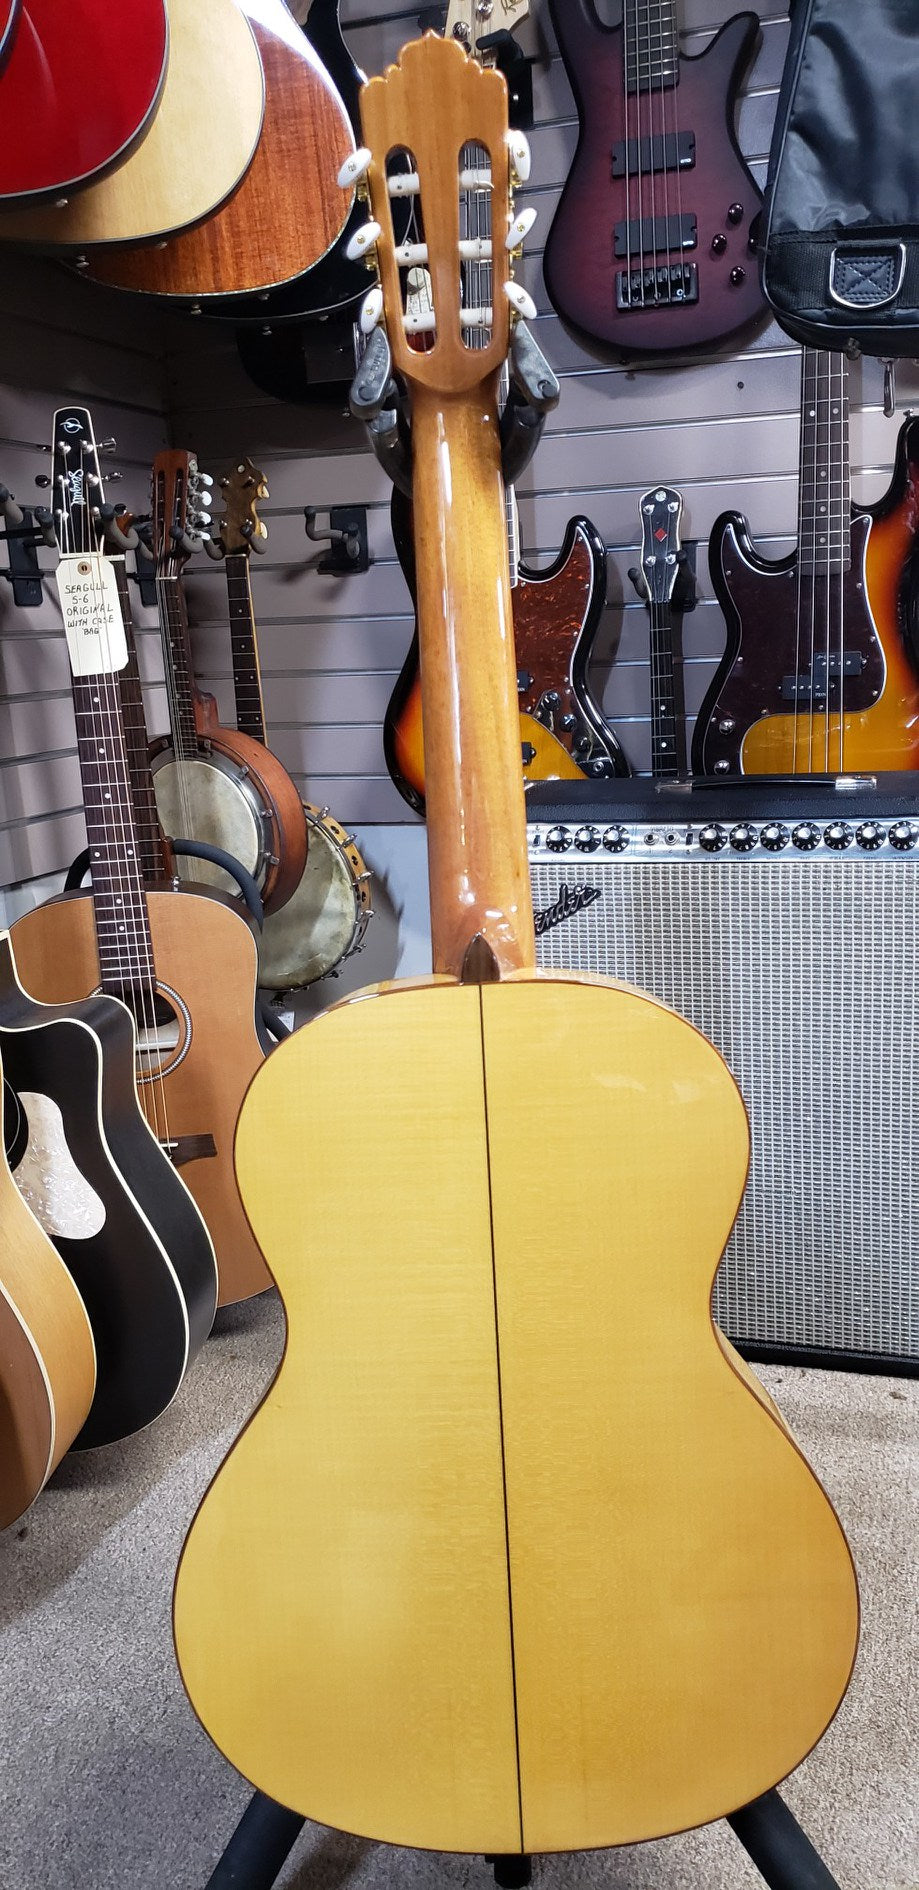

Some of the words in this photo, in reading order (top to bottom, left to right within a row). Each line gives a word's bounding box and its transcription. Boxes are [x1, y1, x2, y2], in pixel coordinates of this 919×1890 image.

[68, 469, 86, 507] Seagull
[65, 581, 108, 594] SEAGULL
[66, 603, 114, 616] ORIGINAL
[67, 618, 88, 628] WITH
[92, 615, 114, 625] CASE
[535, 884, 602, 935] ender
